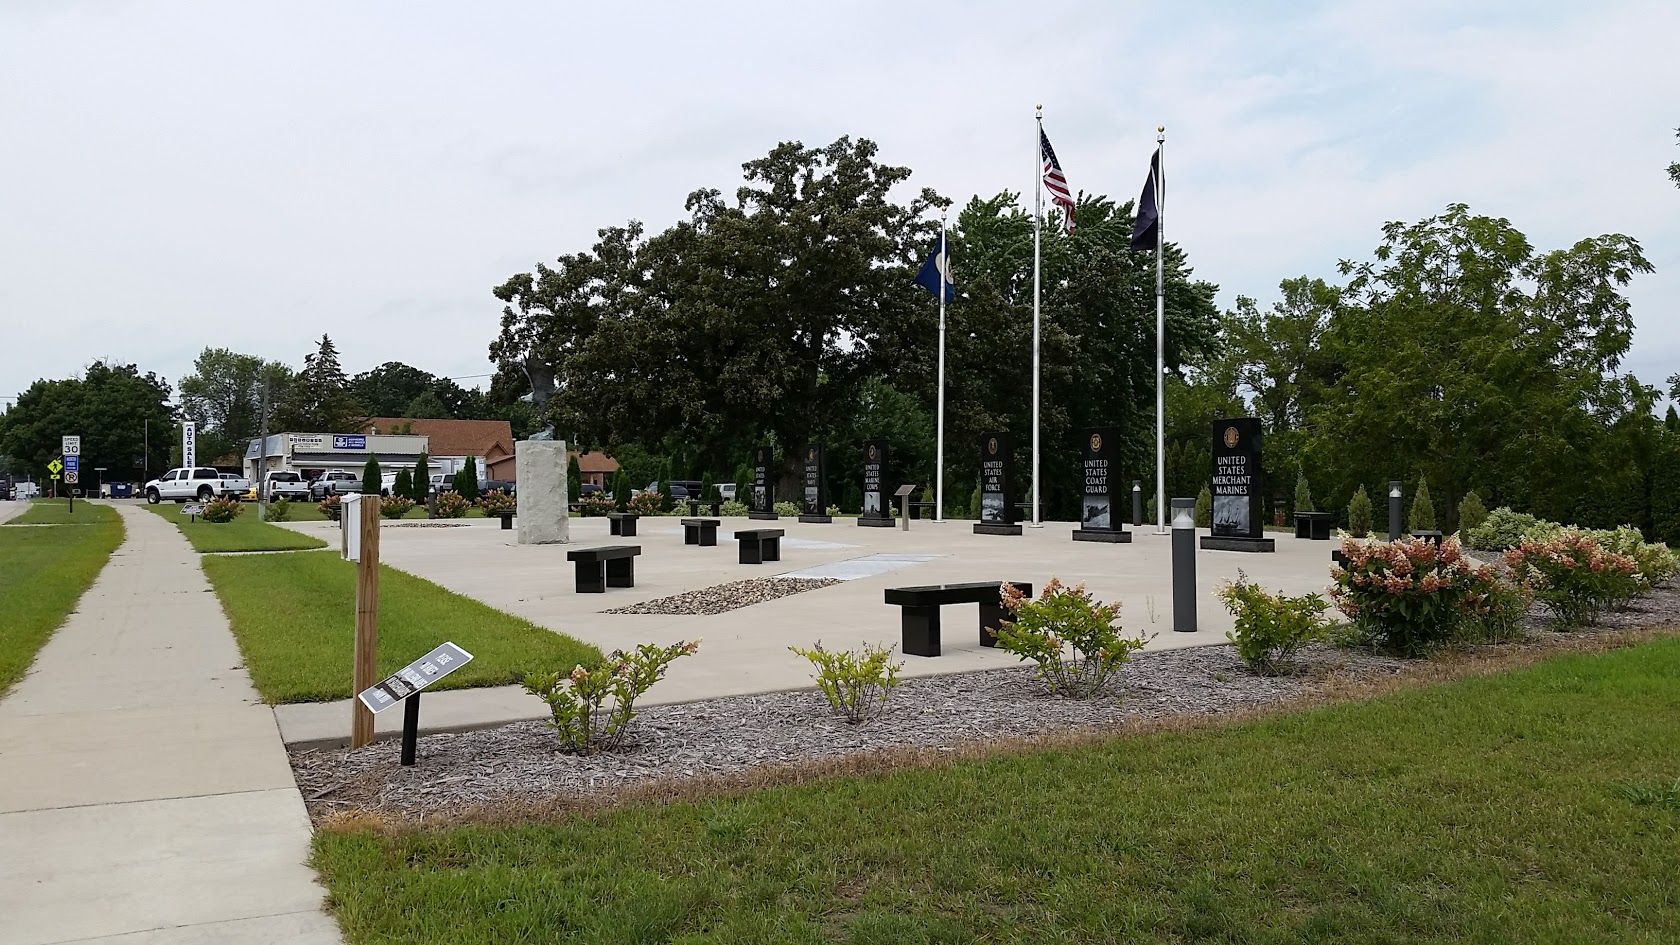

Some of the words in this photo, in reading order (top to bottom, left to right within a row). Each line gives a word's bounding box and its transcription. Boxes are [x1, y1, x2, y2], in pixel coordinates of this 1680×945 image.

[64, 445, 79, 453] 30
[1084, 459, 1109, 468] UNITED
[1217, 456, 1246, 465] UNITED
[984, 468, 1002, 476] STATES
[1085, 468, 1108, 476] STATES
[1218, 466, 1245, 475] STATES
[988, 476, 998, 484] AIR
[1085, 477, 1107, 485] COAST
[1212, 475, 1252, 485] MERCHANT
[1085, 485, 1108, 494] GUARD
[1216, 485, 1248, 495] MARINES
